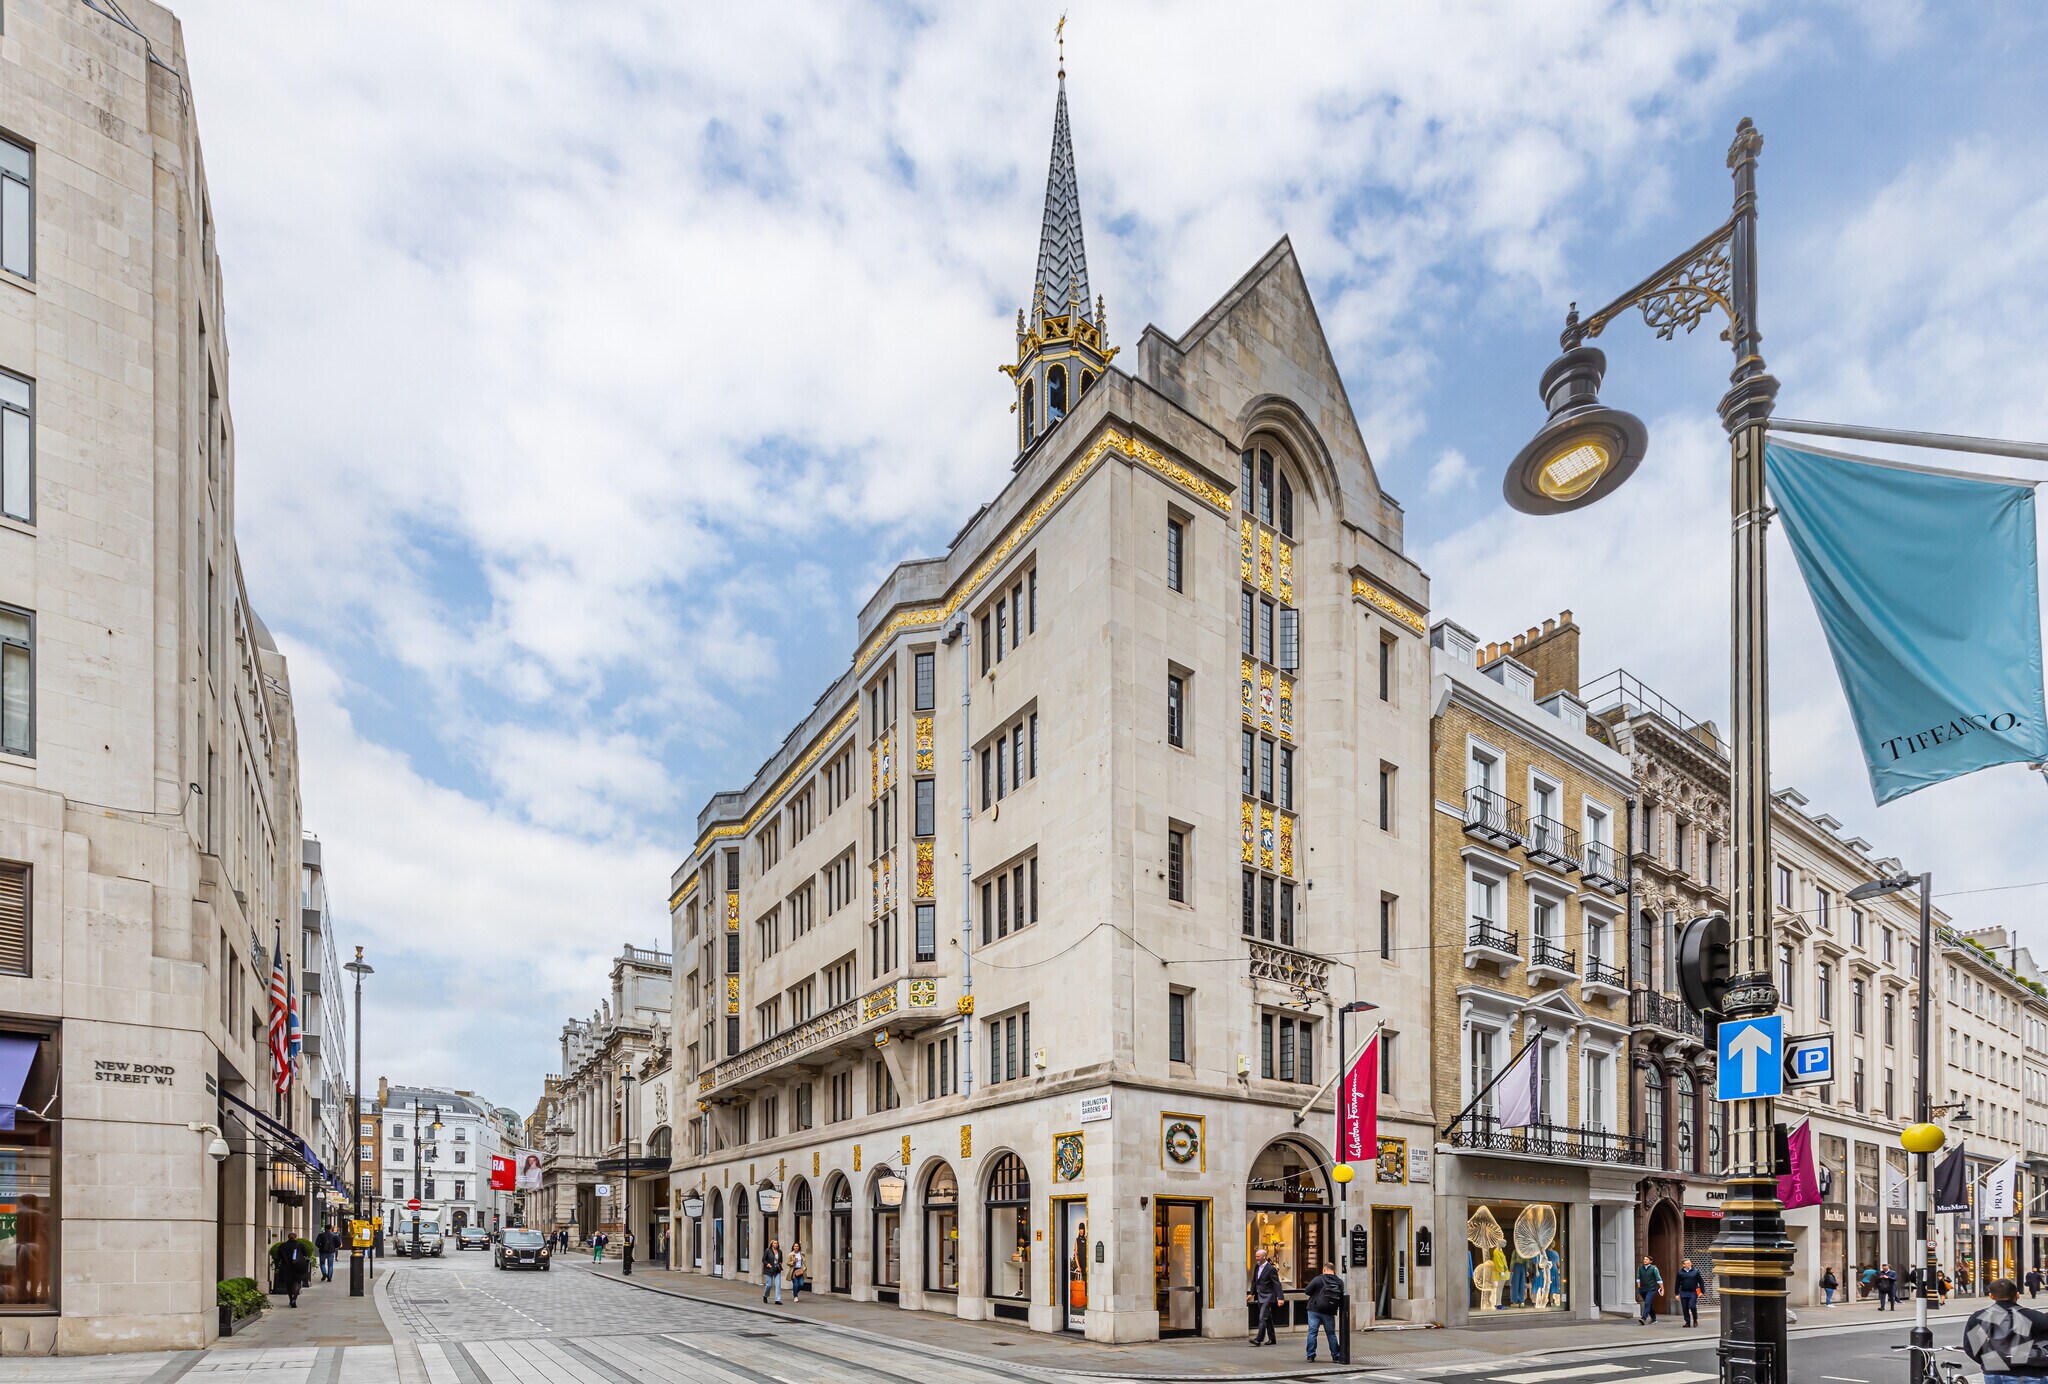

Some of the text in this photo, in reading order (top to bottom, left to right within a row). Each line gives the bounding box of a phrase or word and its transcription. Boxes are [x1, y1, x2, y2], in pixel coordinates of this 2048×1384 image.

[1805, 1050, 1825, 1072] P
[95, 1060, 175, 1075] NEW BOND
[95, 1072, 173, 1086] STREET W1
[1082, 1097, 1108, 1108] BURLINGTON
[1082, 1105, 1101, 1115] GARDENS
[492, 1160, 505, 1172] RA
[1788, 1142, 1803, 1203] CHATILA
[1995, 1179, 2004, 1209] PRADA
[1937, 1204, 1968, 1212] MaxMara
[1824, 1209, 1845, 1222] MaxMara
[1859, 1212, 1878, 1224] MaxMara
[1890, 1214, 1907, 1225] MaxMara
[1420, 1241, 1430, 1253] 24
